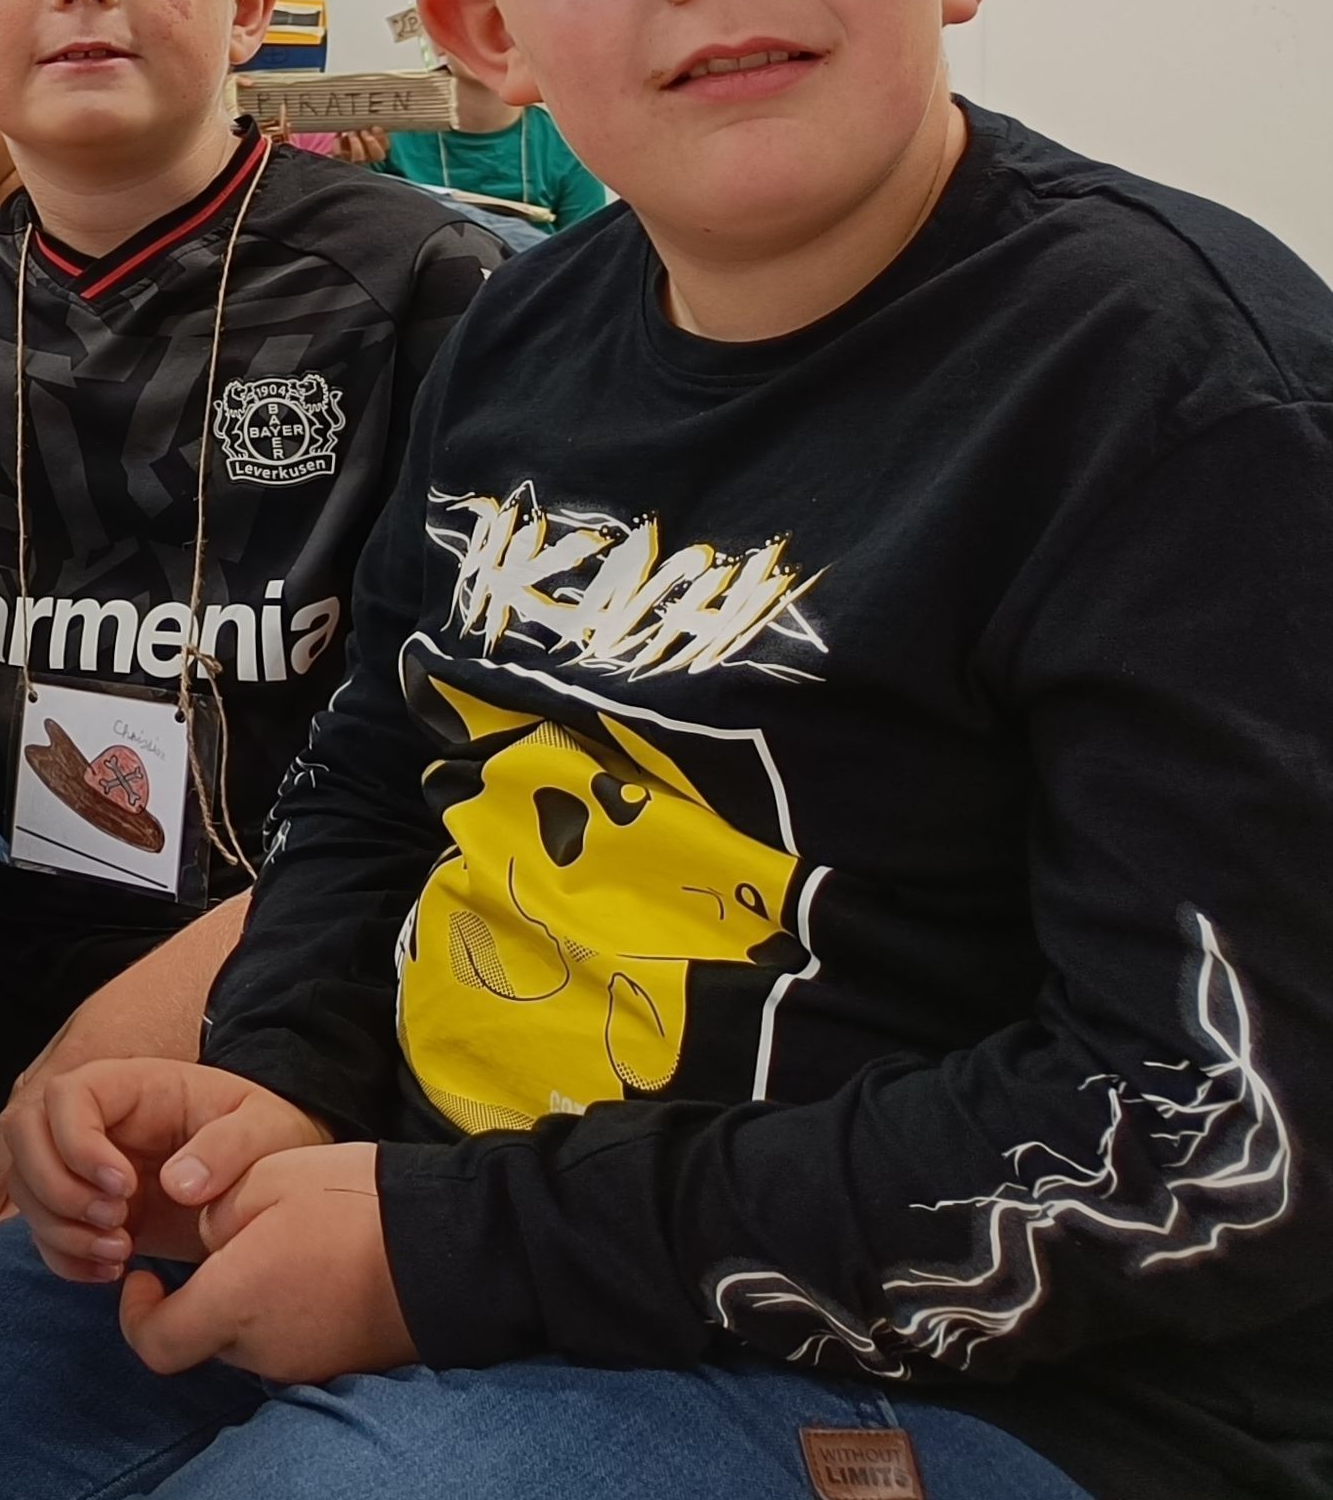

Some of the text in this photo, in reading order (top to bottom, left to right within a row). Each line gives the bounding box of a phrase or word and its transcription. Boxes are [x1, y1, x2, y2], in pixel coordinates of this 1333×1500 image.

[257, 92, 411, 117] PIRATEN
[256, 384, 286, 398] 1904
[249, 425, 304, 438] BAYER
[235, 459, 326, 480] Leverkusen
[820, 1448, 902, 1464] WITHOUT
[826, 1465, 909, 1487] LIMITS
